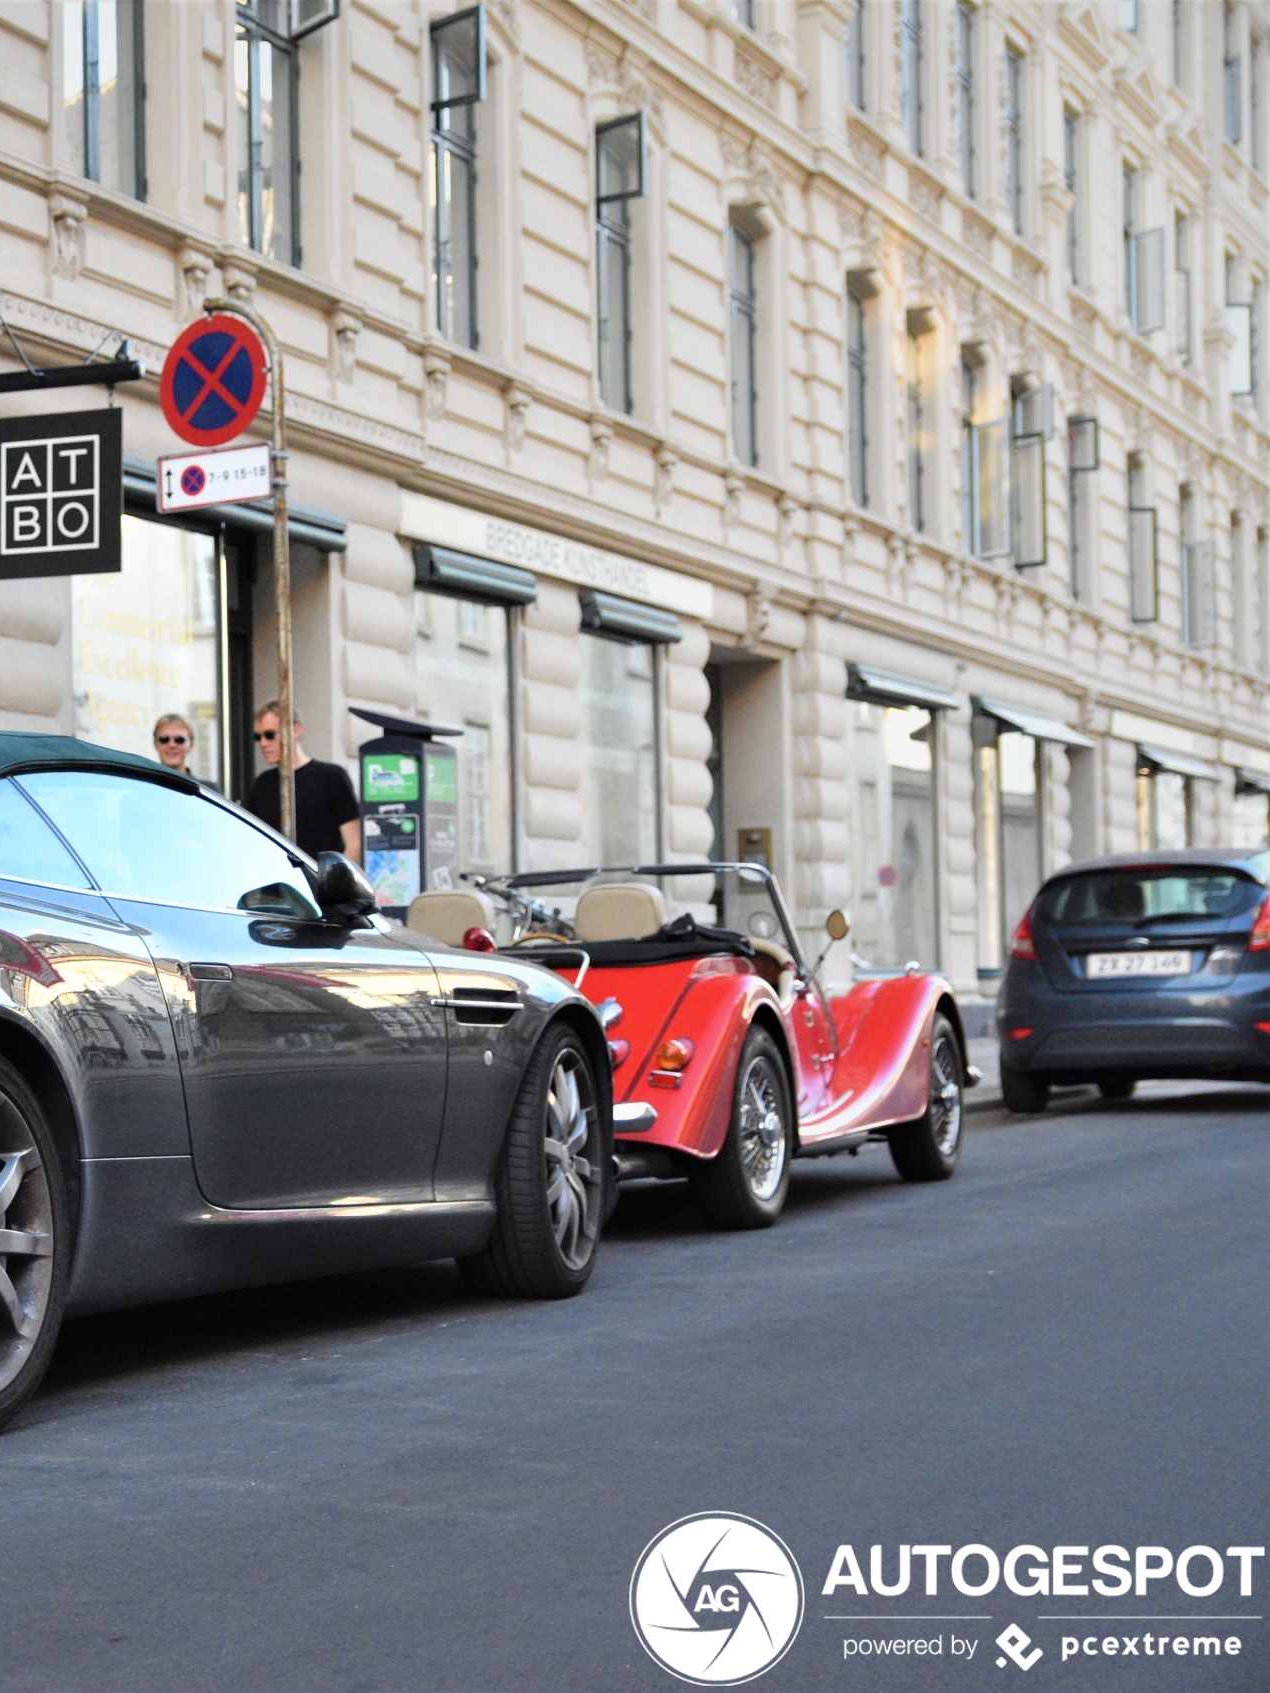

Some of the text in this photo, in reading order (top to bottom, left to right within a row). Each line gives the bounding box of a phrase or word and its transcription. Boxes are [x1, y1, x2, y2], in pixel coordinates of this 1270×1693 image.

[209, 465, 267, 483] 7-9 15-18
[486, 522, 559, 569] BREDGADE
